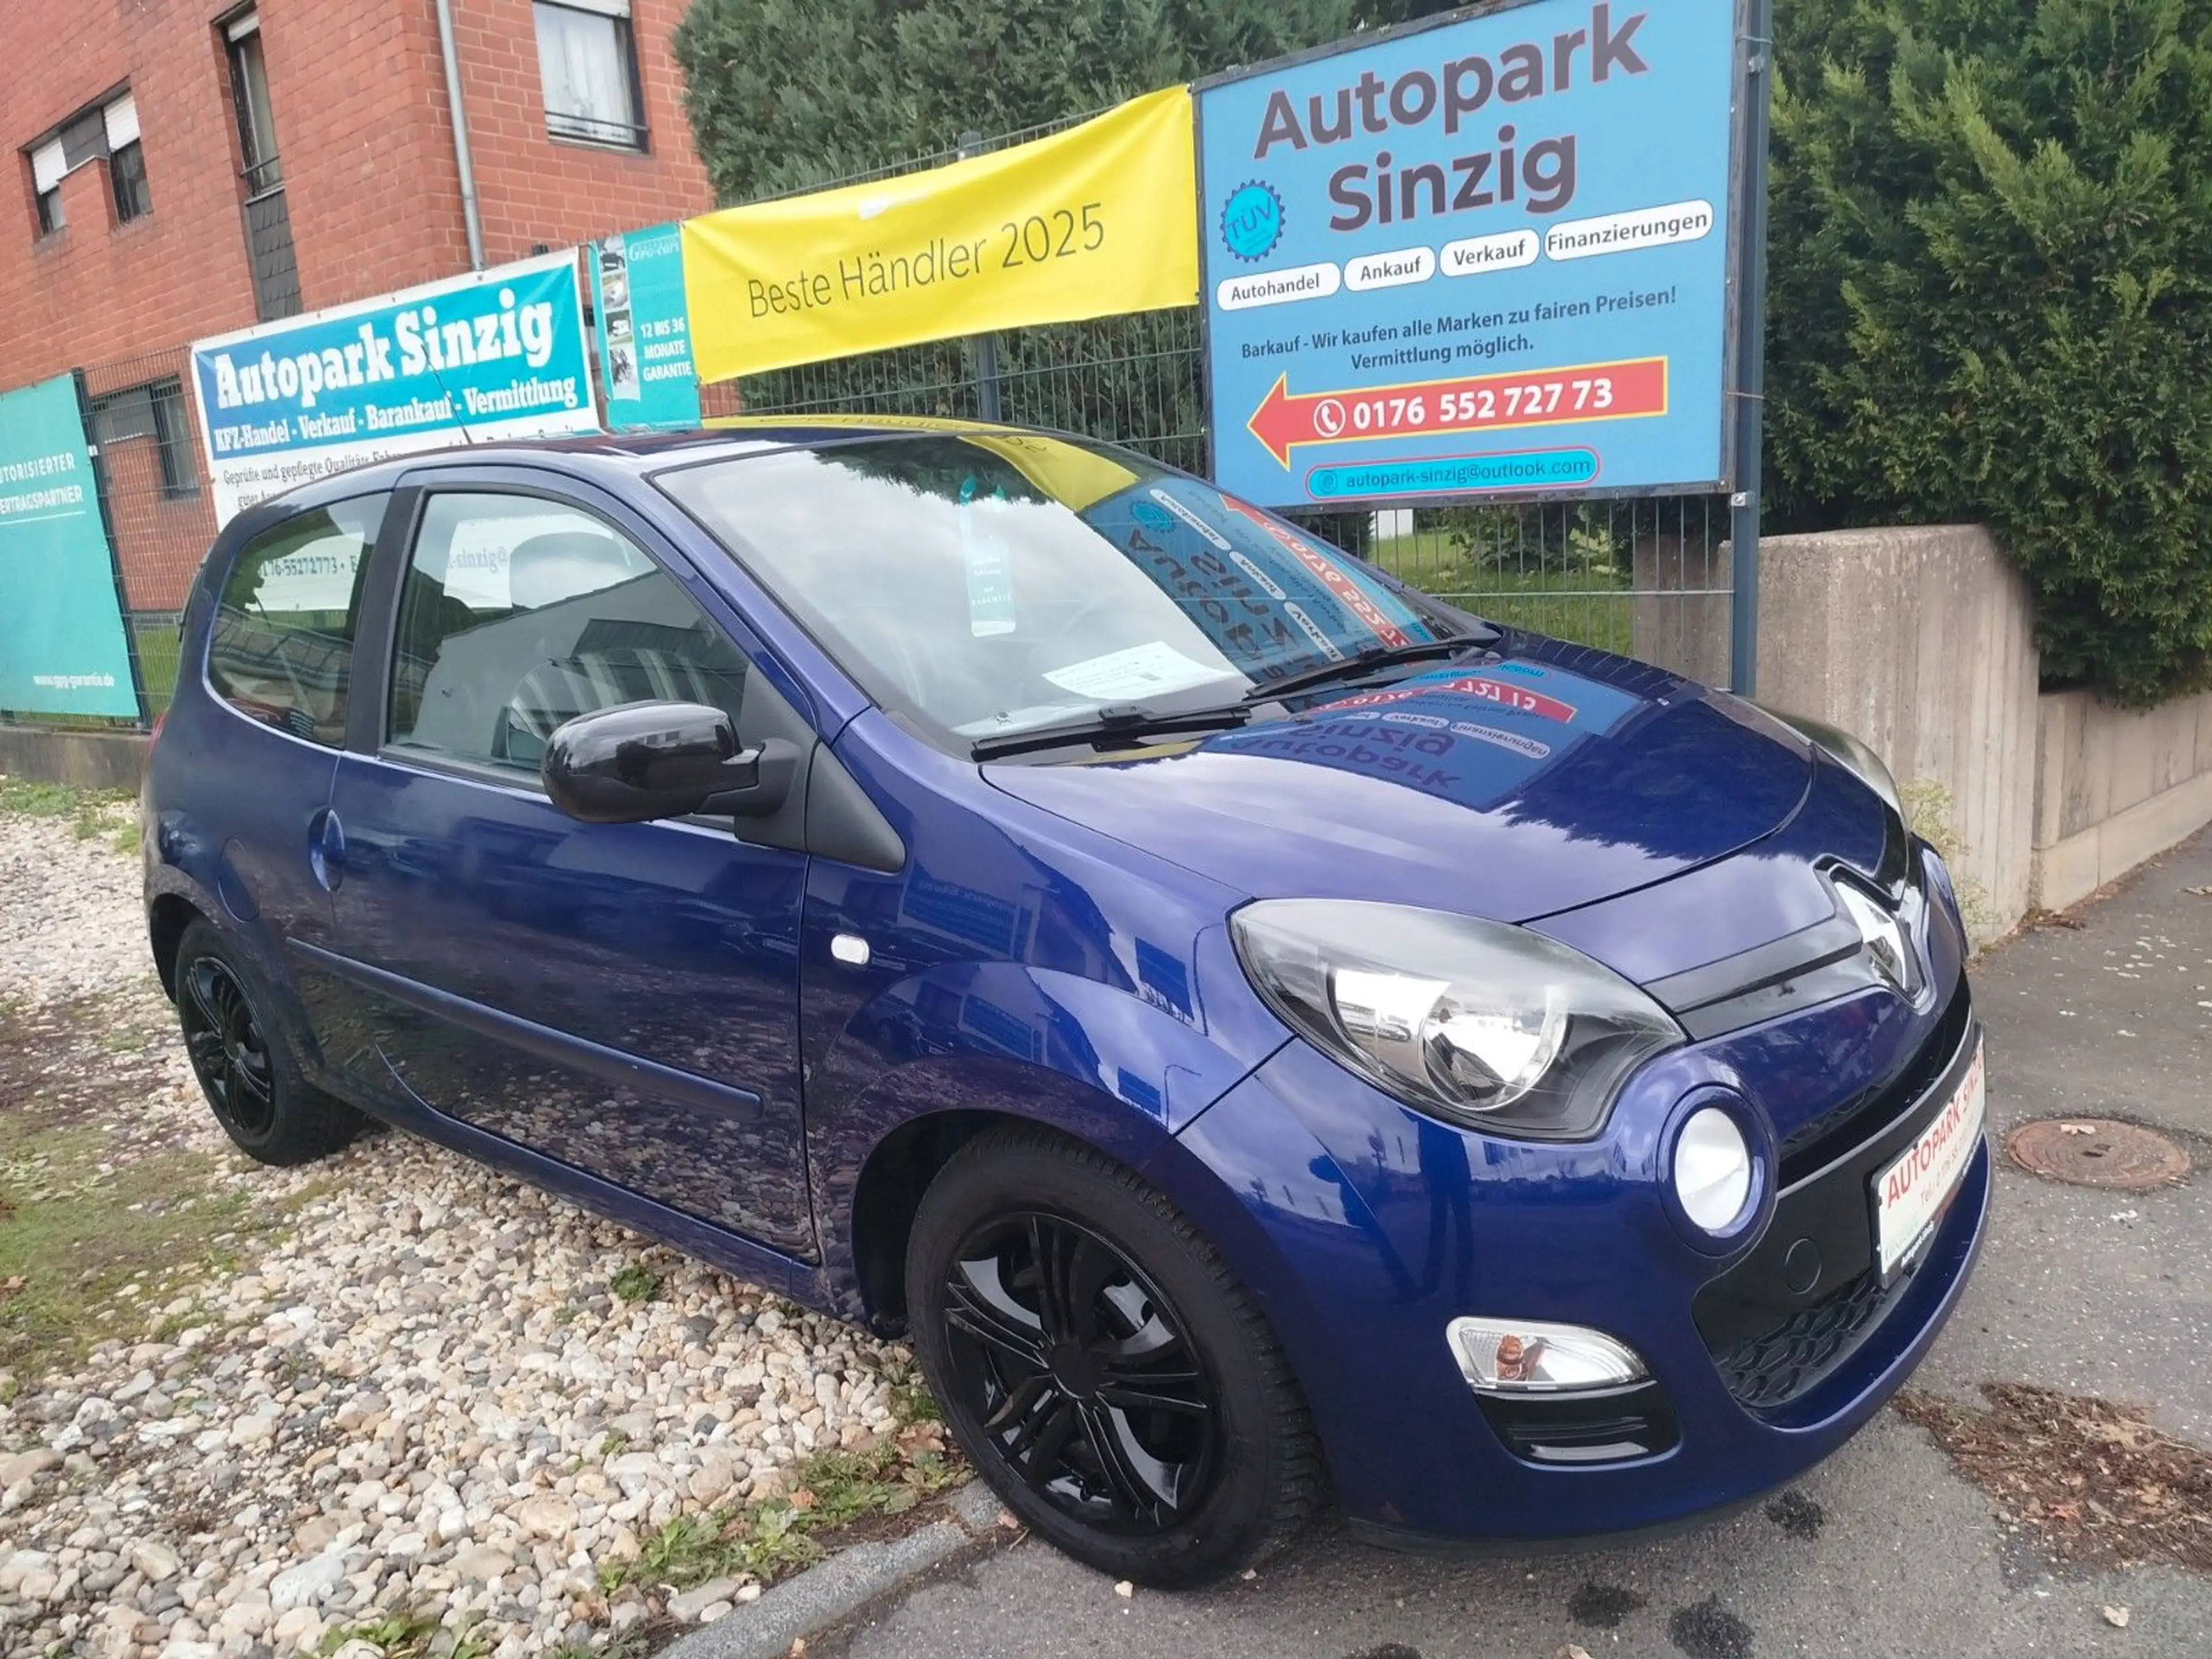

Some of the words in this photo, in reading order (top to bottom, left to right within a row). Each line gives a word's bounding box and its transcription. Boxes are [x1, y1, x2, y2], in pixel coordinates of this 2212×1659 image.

[1253, 3, 1649, 160] Autopark
[1328, 125, 1576, 232] Sinzig
[748, 270, 832, 319] Beste
[839, 237, 987, 301] Händler
[1001, 203, 1104, 269] 2025
[1231, 272, 1320, 302] Autohandel
[1360, 255, 1422, 282] Ankauf
[1453, 239, 1527, 267] Verkauf
[1547, 212, 1708, 252] Finanzierungen
[214, 321, 394, 410] Autopark
[395, 288, 552, 375] Sinzig
[639, 322, 654, 339] 12
[654, 319, 671, 337] BIS
[672, 316, 685, 333] 36
[643, 339, 686, 360] MONATE
[1241, 335, 1301, 359] Barkauf
[1312, 332, 1338, 349] Wir
[1342, 324, 1398, 344] kaufen
[1402, 319, 1433, 338] alle
[1437, 312, 1503, 334] Marken
[1508, 310, 1530, 325] zu
[1535, 300, 1590, 321] fairen
[1596, 286, 1676, 314] Preisen!
[1351, 345, 1452, 370] Vermittlung
[1456, 334, 1535, 359] möglich.
[642, 361, 693, 381] GARANTIE
[1353, 396, 1426, 430] 0176
[1439, 389, 1496, 422] 552
[1503, 383, 1563, 417] 727
[1571, 378, 1613, 411] 73
[214, 418, 290, 452] KFZ-Handel
[298, 411, 357, 440] Verkauf
[365, 391, 453, 431] Barankauf
[463, 376, 578, 416] Vermittlung
[262, 464, 279, 480] und
[281, 460, 323, 483] gepflegte
[1887, 1097, 1961, 1210] AUTOPARK
